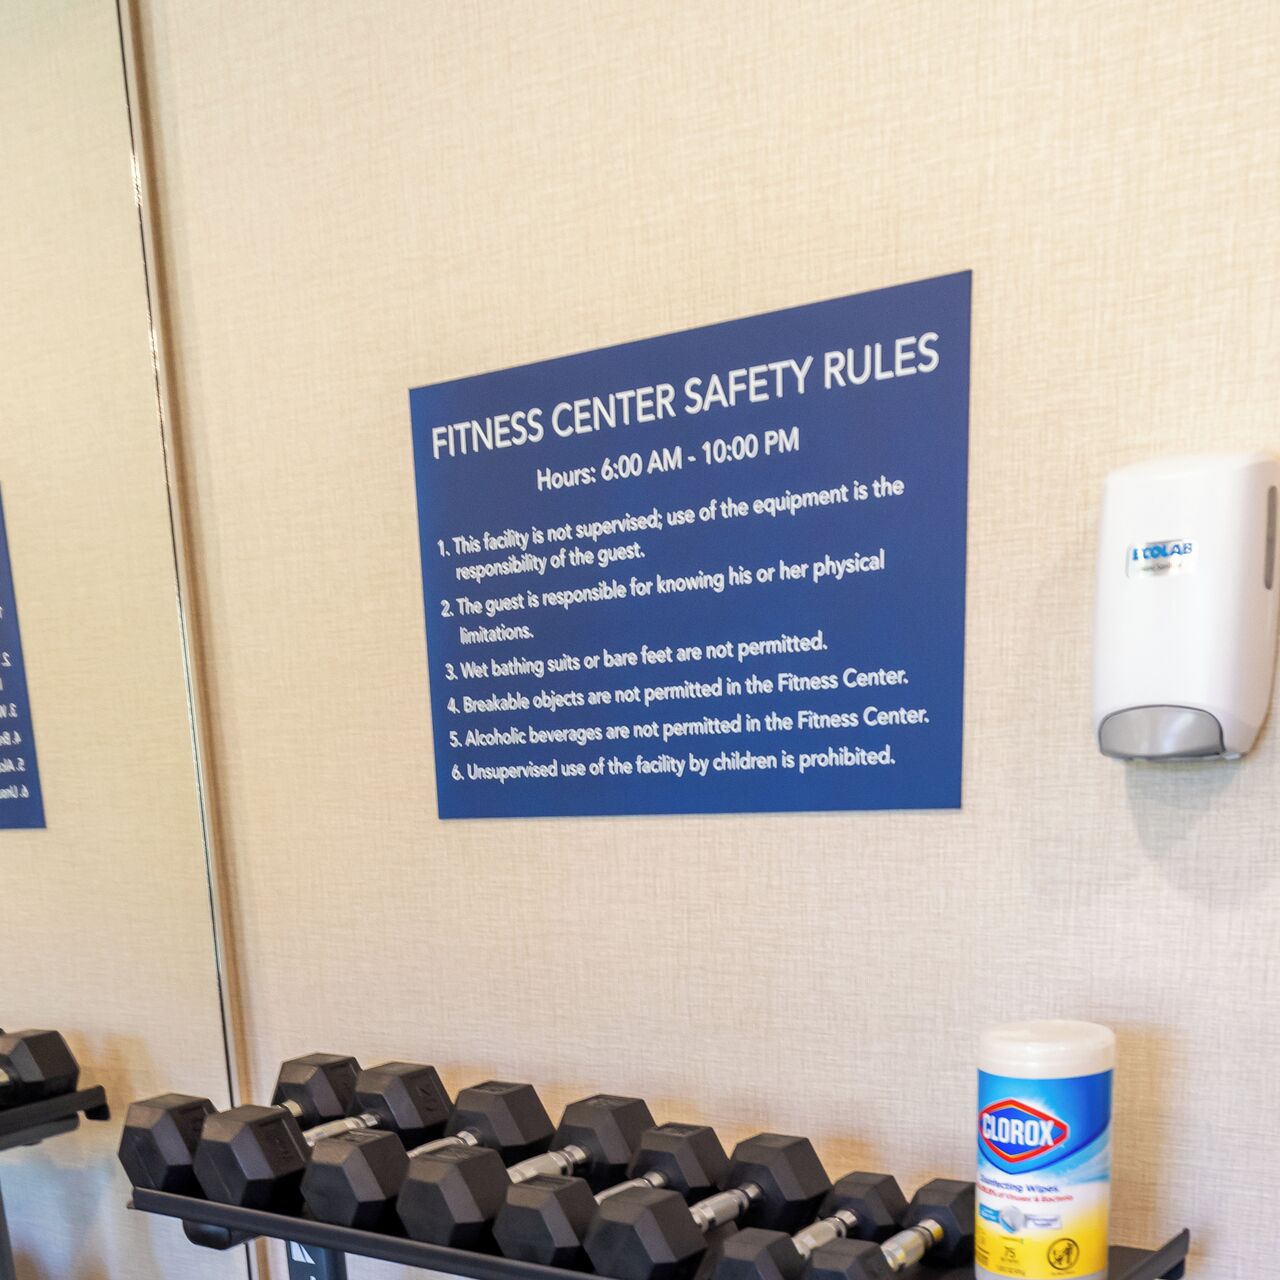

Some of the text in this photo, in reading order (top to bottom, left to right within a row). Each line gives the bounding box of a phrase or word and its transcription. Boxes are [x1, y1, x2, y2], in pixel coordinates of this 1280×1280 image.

[431, 331, 939, 460] FITNESS CENTER SAFETY RULES
[536, 465, 596, 491] Hours:
[600, 451, 643, 481] 6:00
[646, 445, 682, 474] AM
[700, 432, 759, 465] 10:00
[763, 425, 799, 455] PM
[436, 474, 905, 557] 1. This facility is not supervised; use of the equipment is the
[440, 547, 885, 618] 2. The guest is responsible for knowing his or her physical
[455, 541, 645, 584] responsibility of the guest.
[444, 629, 828, 680] 3. Wet bathing suits or bare feet are not permitted.
[458, 622, 534, 645] limitations.
[446, 666, 909, 714] 4. Breakable objects are not permitted in the Fitness Center.
[448, 705, 930, 748] 5. Alcoholic beverages are not permitted in the Fitness Center.
[450, 743, 895, 784] 6. Unsupervised use of the facility by children is prohibited.
[982, 1113, 1055, 1146] CLOROX
